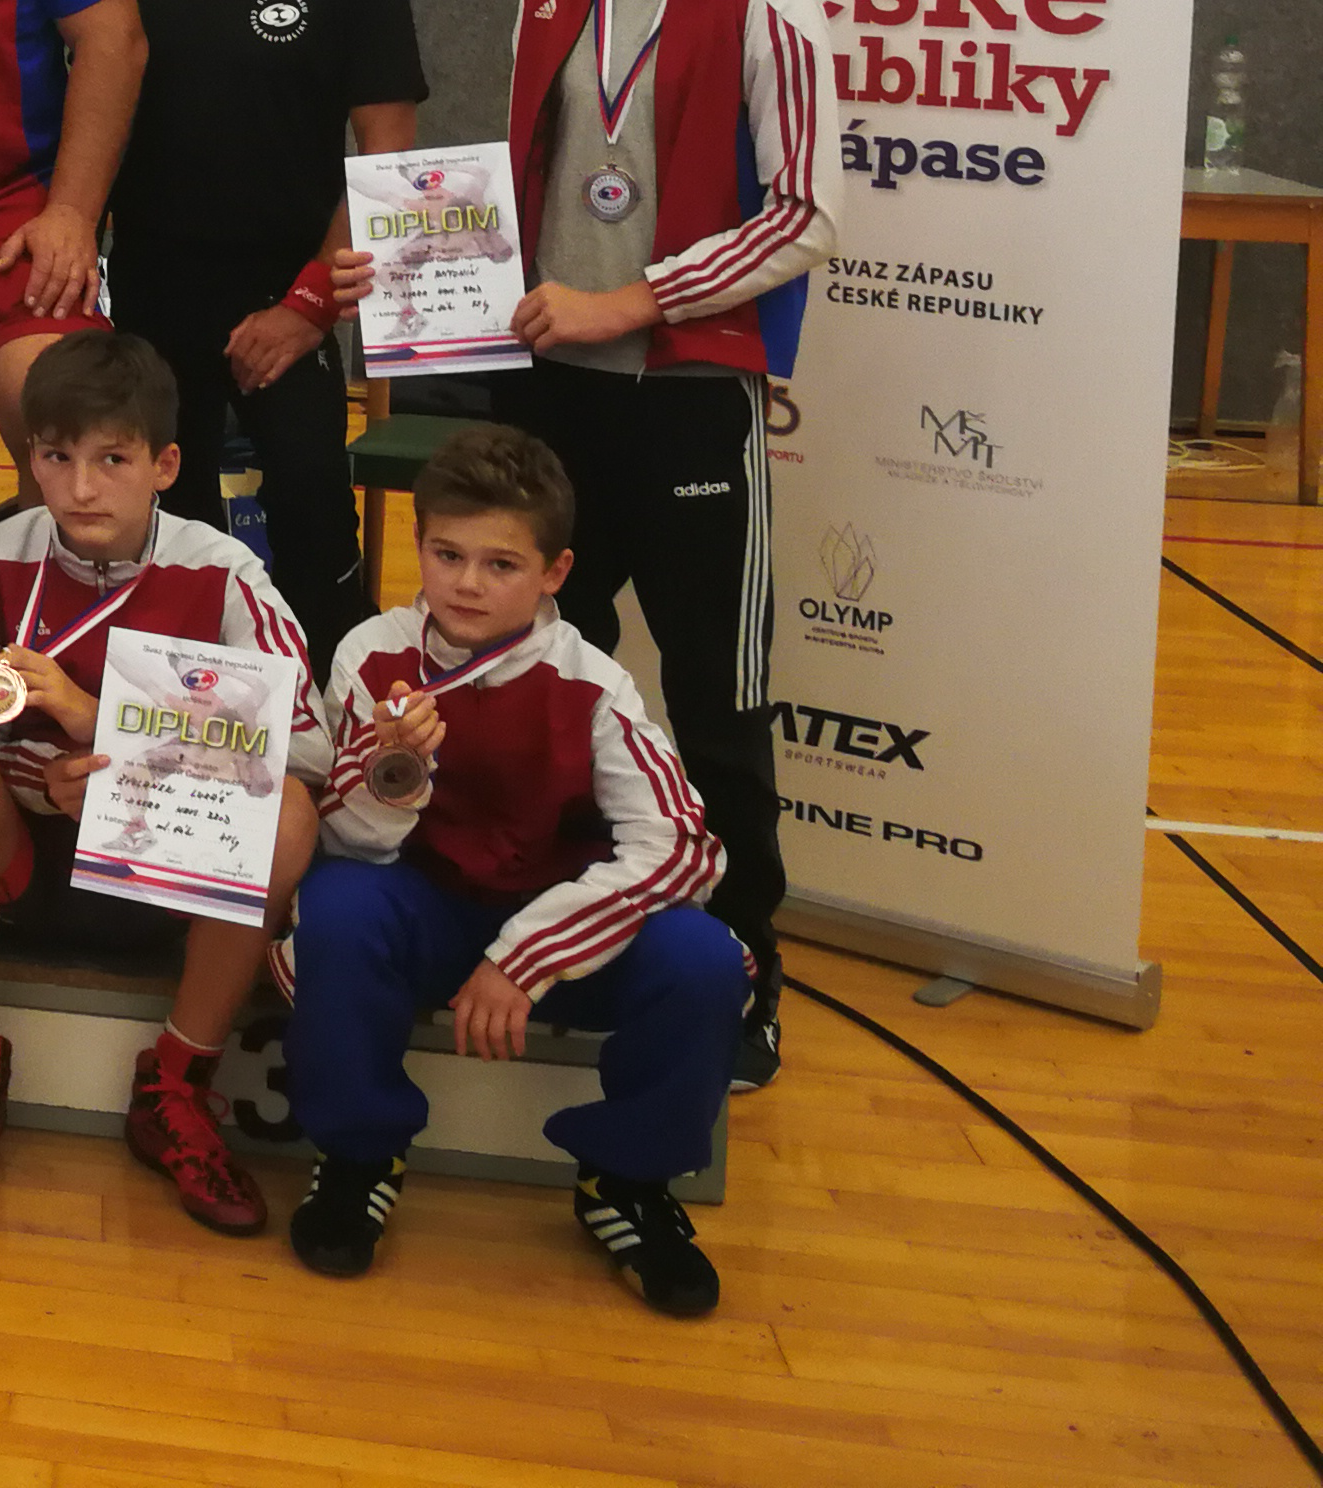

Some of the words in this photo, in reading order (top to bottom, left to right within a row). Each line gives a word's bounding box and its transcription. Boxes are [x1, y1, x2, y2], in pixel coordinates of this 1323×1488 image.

[832, 36, 1110, 137] ubliky
[841, 118, 1046, 190] ápase
[366, 202, 499, 242] DIPLOM
[828, 256, 888, 281] SVAZ
[896, 258, 994, 292] ZÁPASU
[825, 280, 900, 310] ČESKÉ
[906, 292, 1045, 326] REPUBLIKY
[766, 448, 804, 464] PORTU
[673, 480, 731, 499] adidas
[798, 598, 893, 633] OLYMP
[116, 701, 268, 757] DIPLOM
[769, 701, 932, 772] ATEX
[784, 748, 887, 780] SPORTSWEAR
[776, 795, 873, 838] PINE
[882, 820, 984, 862] PRO
